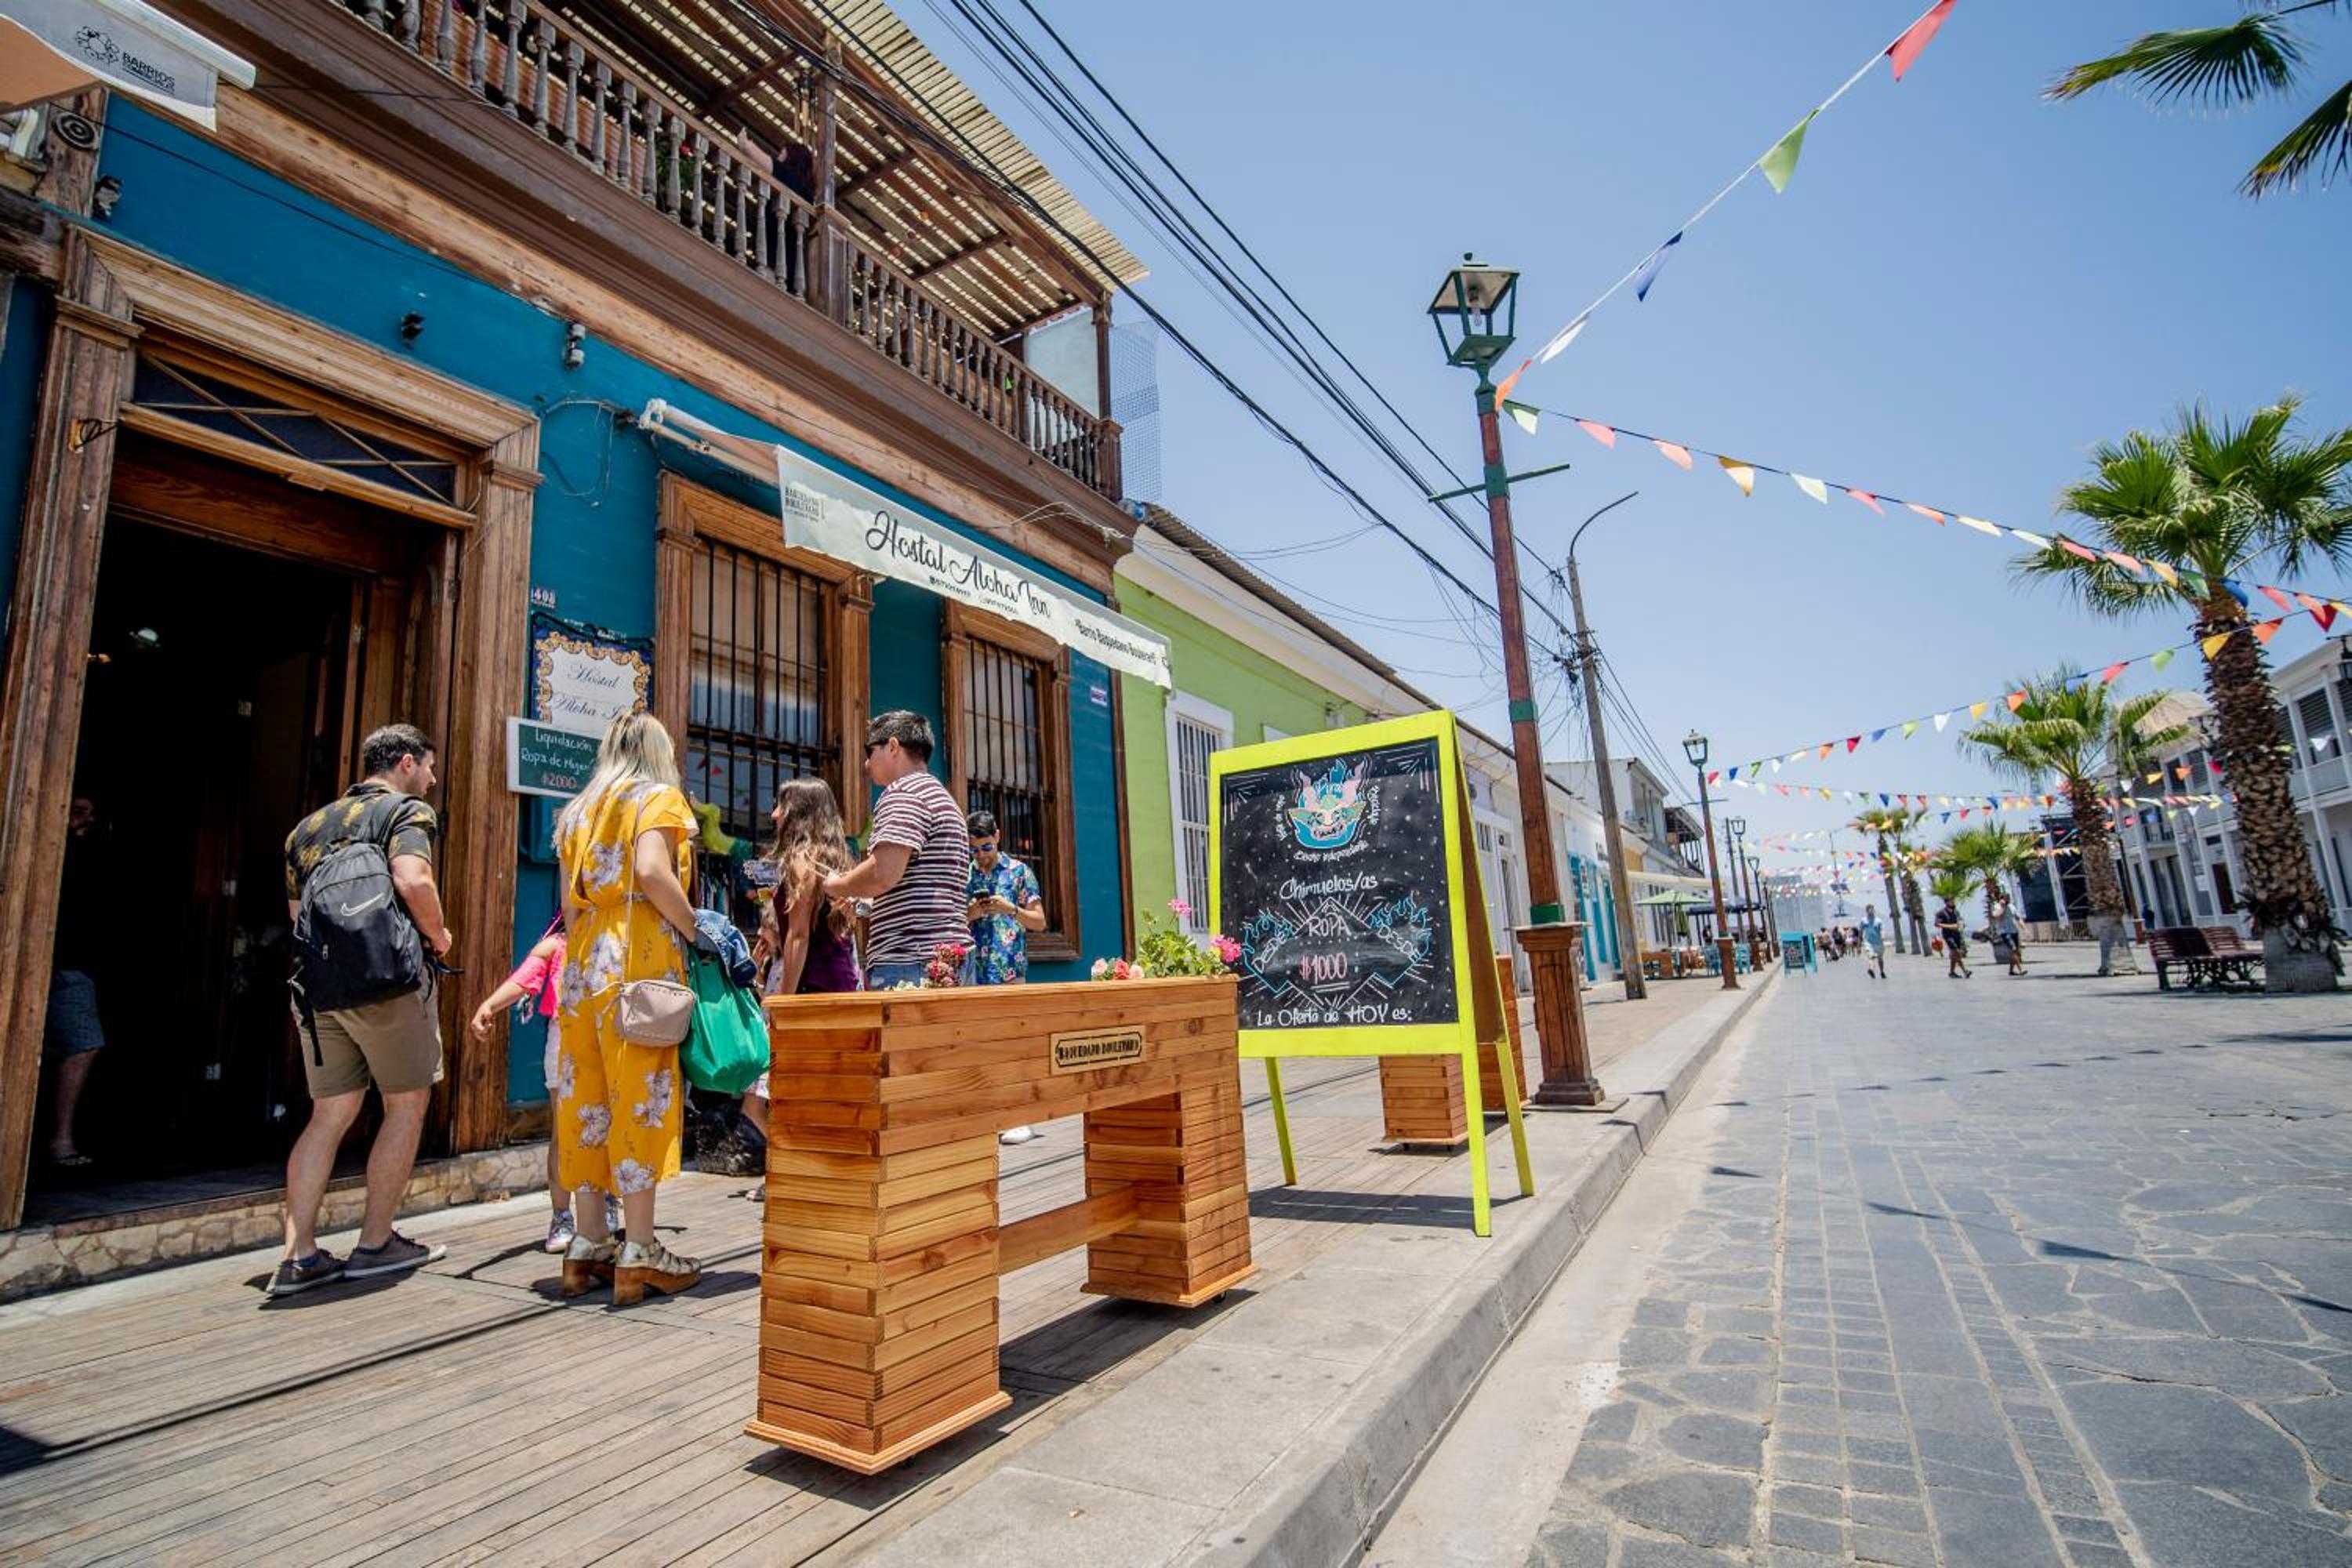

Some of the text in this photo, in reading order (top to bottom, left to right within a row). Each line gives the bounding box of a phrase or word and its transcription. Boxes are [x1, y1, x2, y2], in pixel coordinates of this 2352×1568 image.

[865, 510, 946, 574] Hostal
[949, 554, 1018, 603] Aloha
[1018, 579, 1051, 618] Inn
[566, 664, 620, 689] Hostal
[521, 748, 547, 766] Ropa
[550, 753, 562, 768] de
[1308, 913, 1352, 937] ROPA
[1300, 953, 1348, 984] $1000
[1257, 1010, 1273, 1026] La
[1278, 1007, 1318, 1026] Oferta
[1345, 1004, 1388, 1023] HOY
